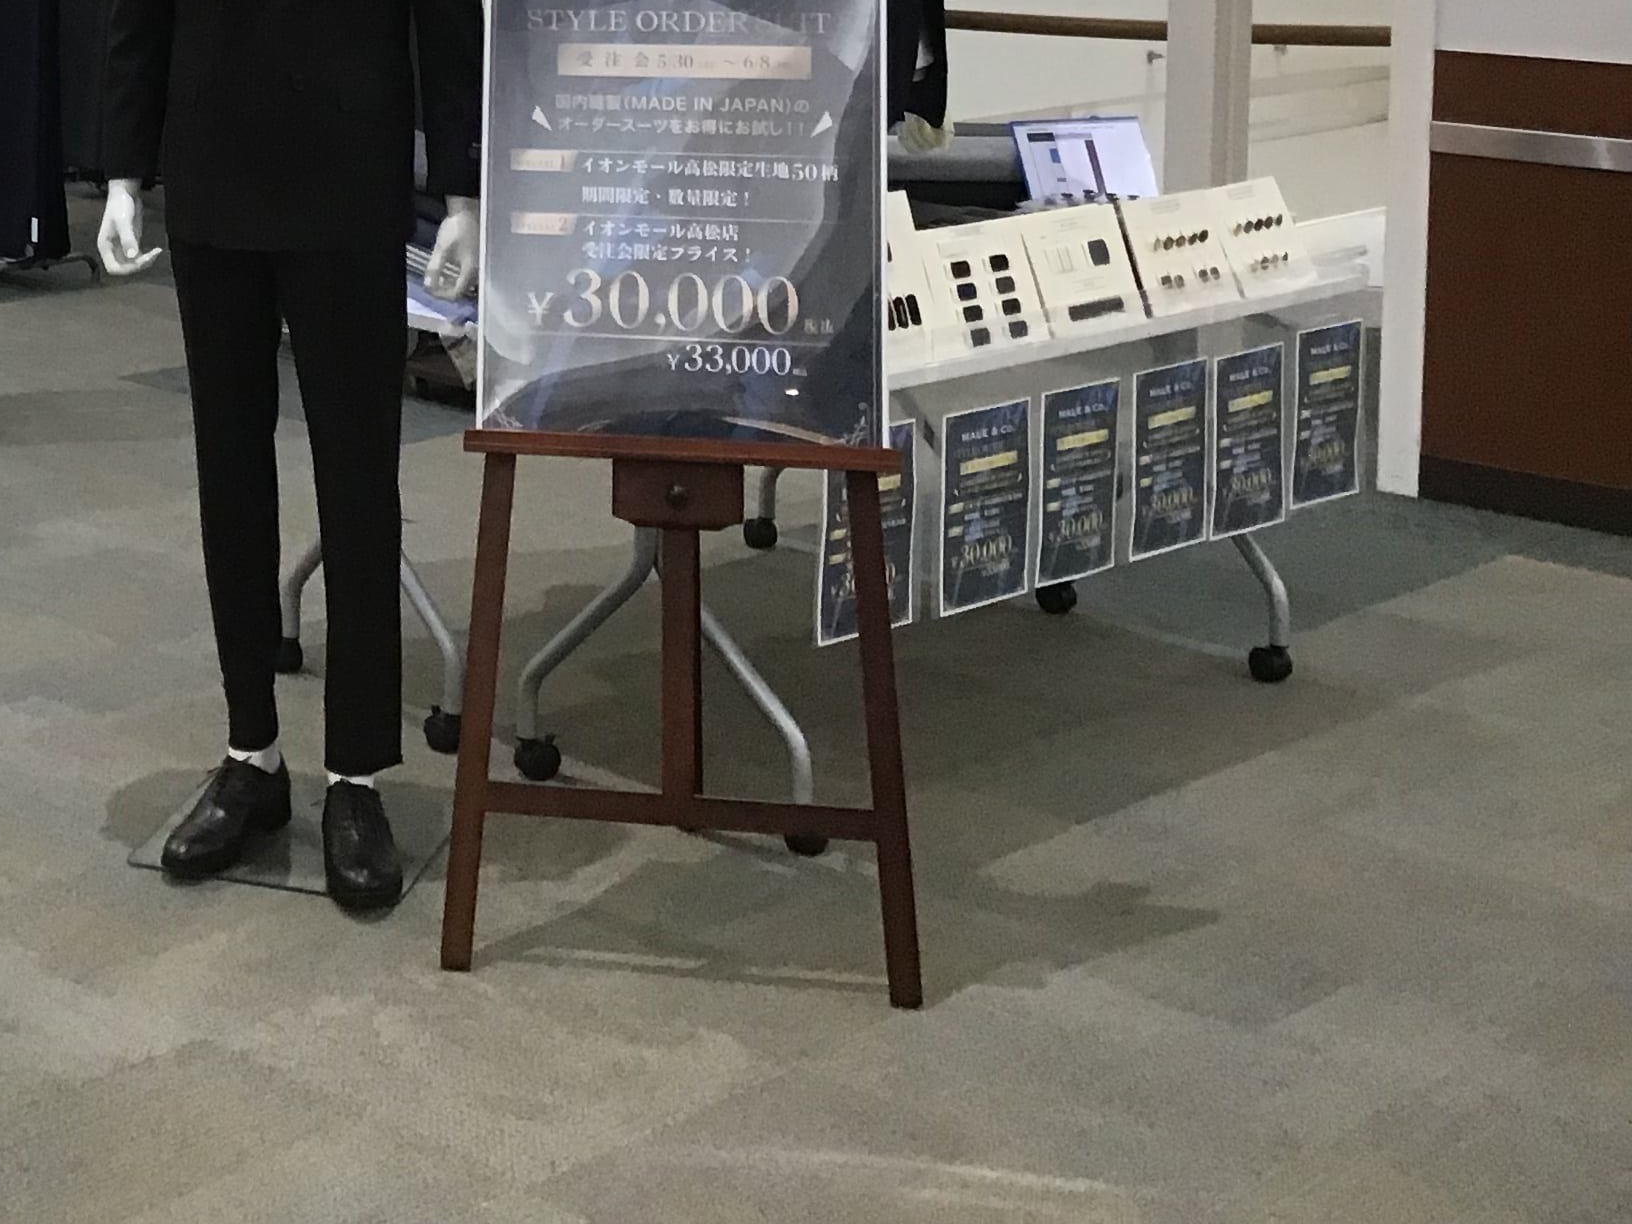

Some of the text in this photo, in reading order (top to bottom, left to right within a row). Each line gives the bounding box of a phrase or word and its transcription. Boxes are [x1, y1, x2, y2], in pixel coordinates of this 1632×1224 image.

[527, 9, 626, 33] STYLE
[636, 10, 749, 34] ORDER
[694, 97, 713, 112] IN
